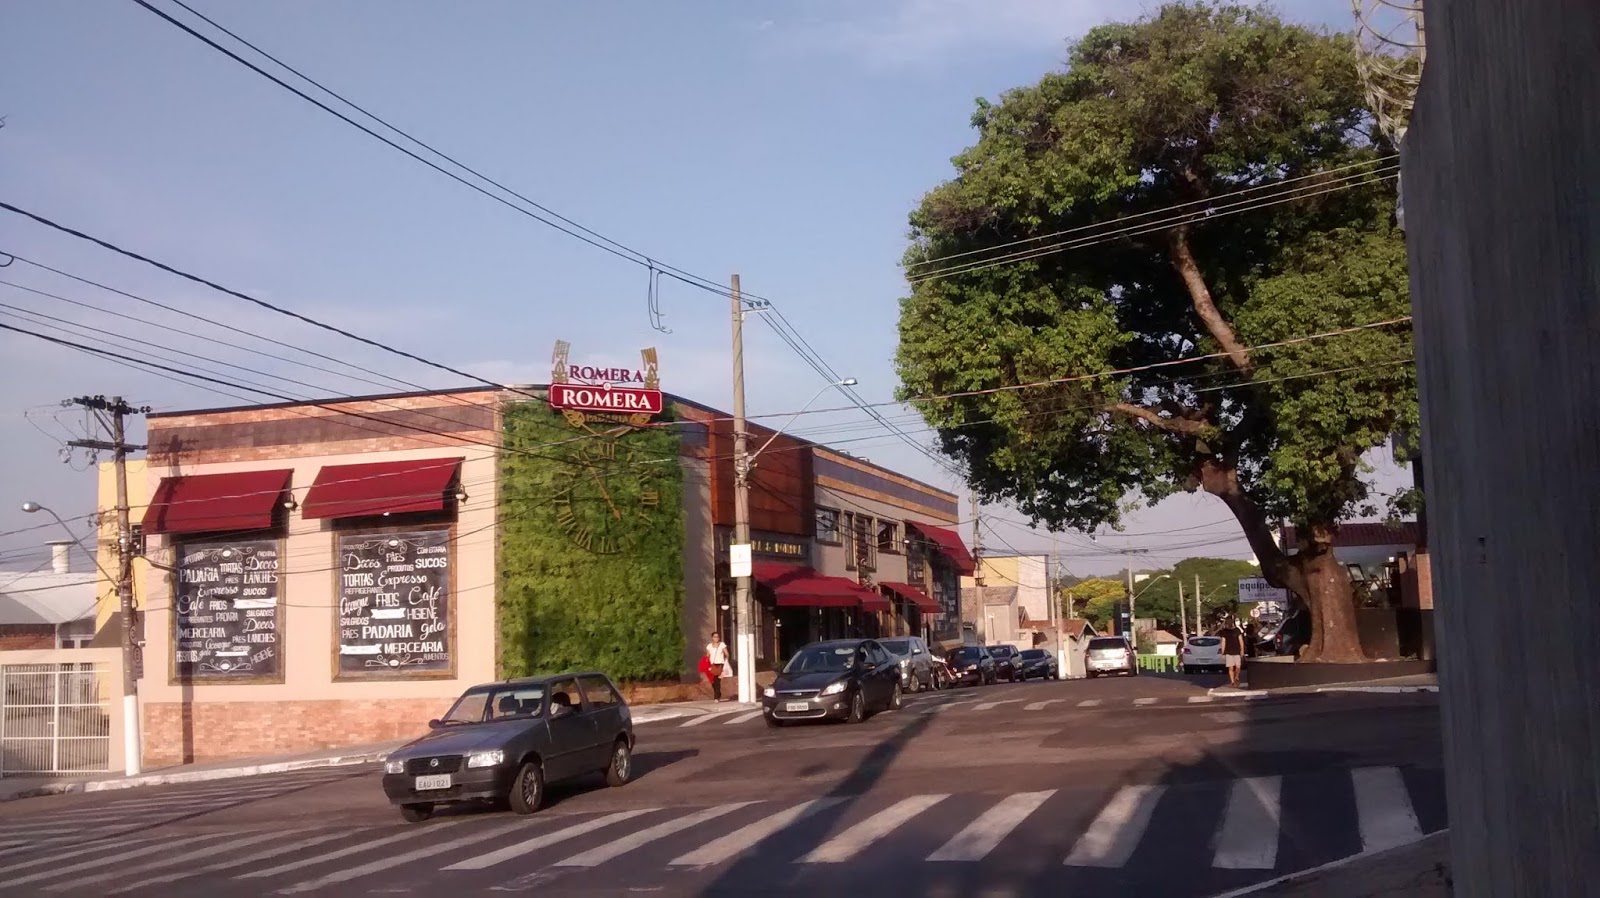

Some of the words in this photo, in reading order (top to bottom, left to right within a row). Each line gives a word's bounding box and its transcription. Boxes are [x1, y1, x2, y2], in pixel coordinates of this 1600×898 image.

[569, 365, 644, 382] ROMERA
[562, 389, 652, 409] ROMERA
[245, 555, 278, 571] Doces
[342, 552, 381, 571] Doces
[386, 551, 405, 562] PÃES
[415, 557, 447, 569] SUCOS
[180, 566, 219, 583] PADARIA
[219, 562, 243, 574] TORTAS
[387, 564, 414, 572] PRODUTOS
[243, 570, 278, 584] LANCHES
[343, 573, 374, 587] TORTAS
[378, 570, 428, 590] Expresso
[198, 584, 239, 598] Expresso
[243, 587, 267, 596] SUCOS
[408, 586, 442, 609] Café
[178, 595, 204, 617] Café
[209, 600, 227, 611] FRIOS
[376, 593, 400, 607] FRIOS
[216, 612, 238, 622] PADARIA
[246, 609, 274, 617] SALGADOS
[242, 618, 275, 633] Doces
[340, 617, 369, 626] SALGADOS
[180, 627, 226, 638] MERCEARIA
[342, 627, 359, 639] PÃES
[362, 624, 414, 639] PADARIA
[420, 618, 446, 640] gelo
[248, 633, 275, 643] LANCHES
[384, 641, 444, 654] MERCEARIA
